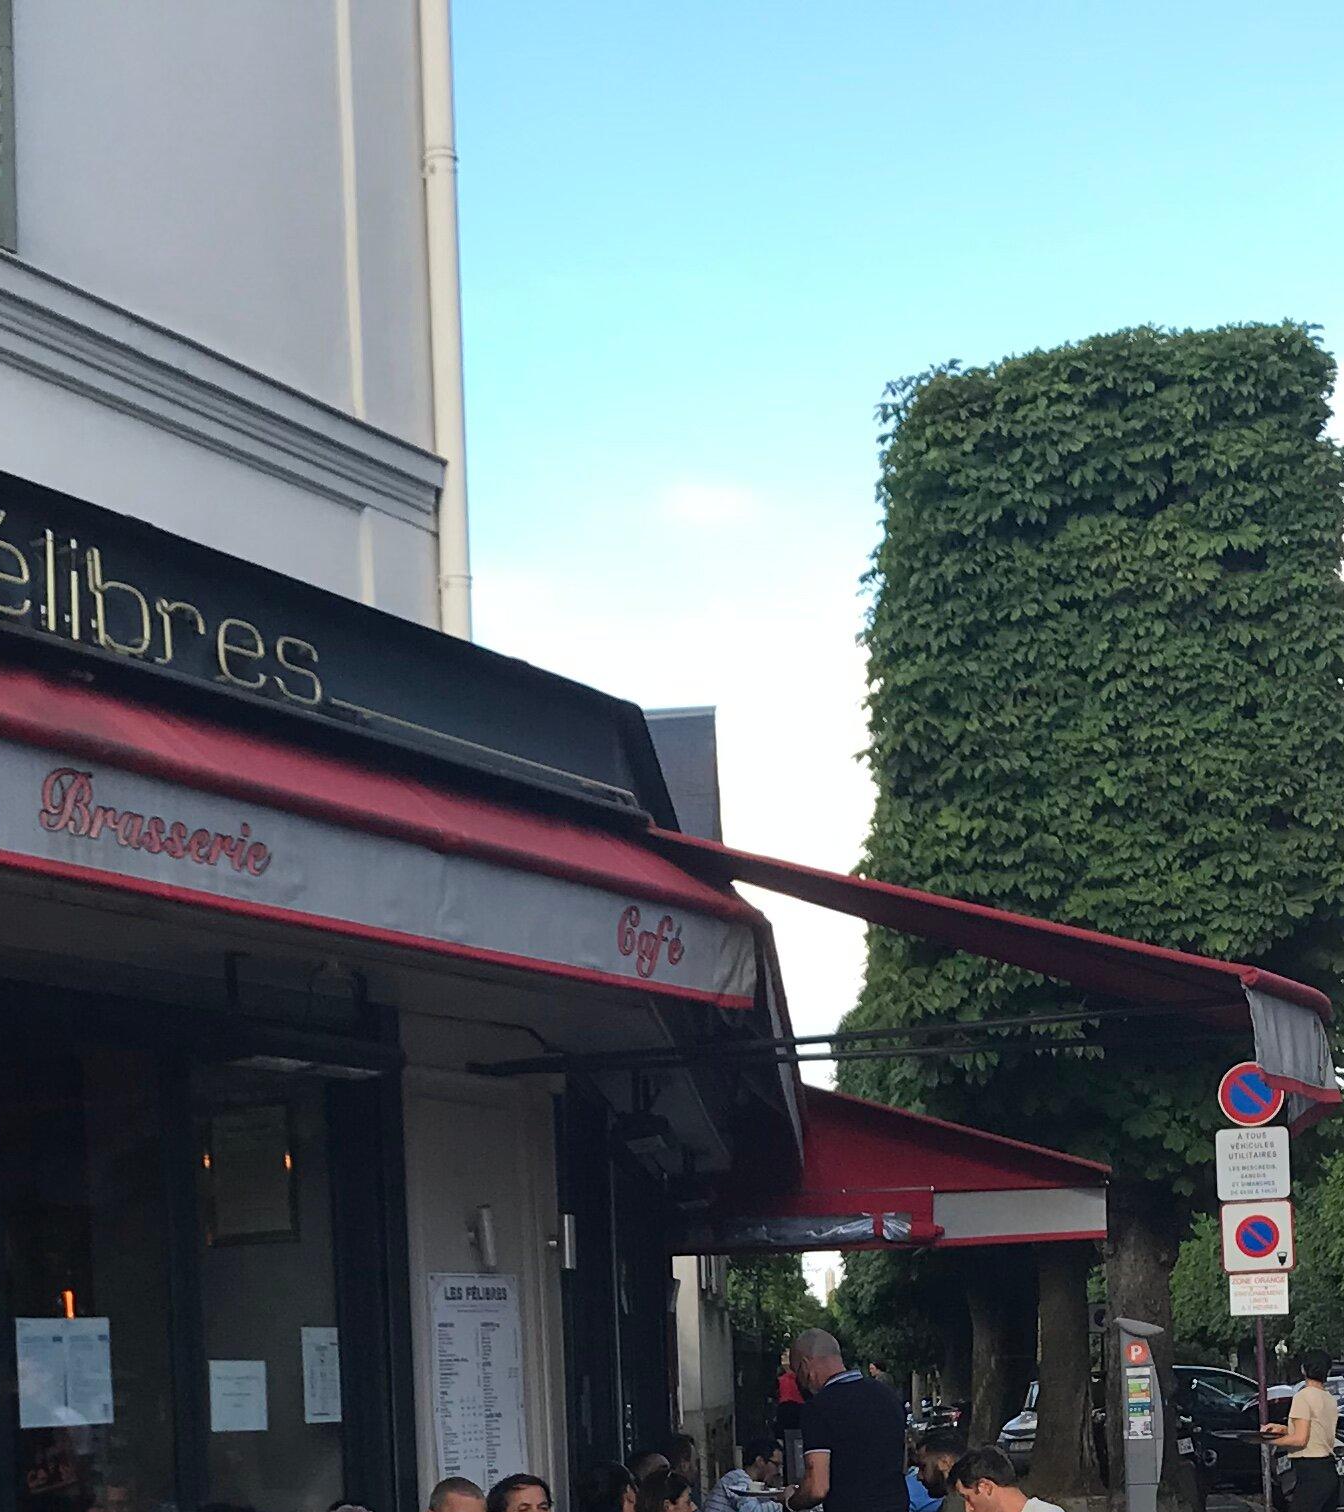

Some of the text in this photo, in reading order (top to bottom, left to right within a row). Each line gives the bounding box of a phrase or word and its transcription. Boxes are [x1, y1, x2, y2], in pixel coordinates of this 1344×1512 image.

[39, 766, 273, 877] Brasserie
[617, 904, 686, 978] Café
[1246, 1131, 1267, 1140] TOUS
[1228, 1151, 1277, 1160] UTILITAIRES
[444, 1286, 463, 1301] LES
[1130, 1344, 1143, 1361] P
